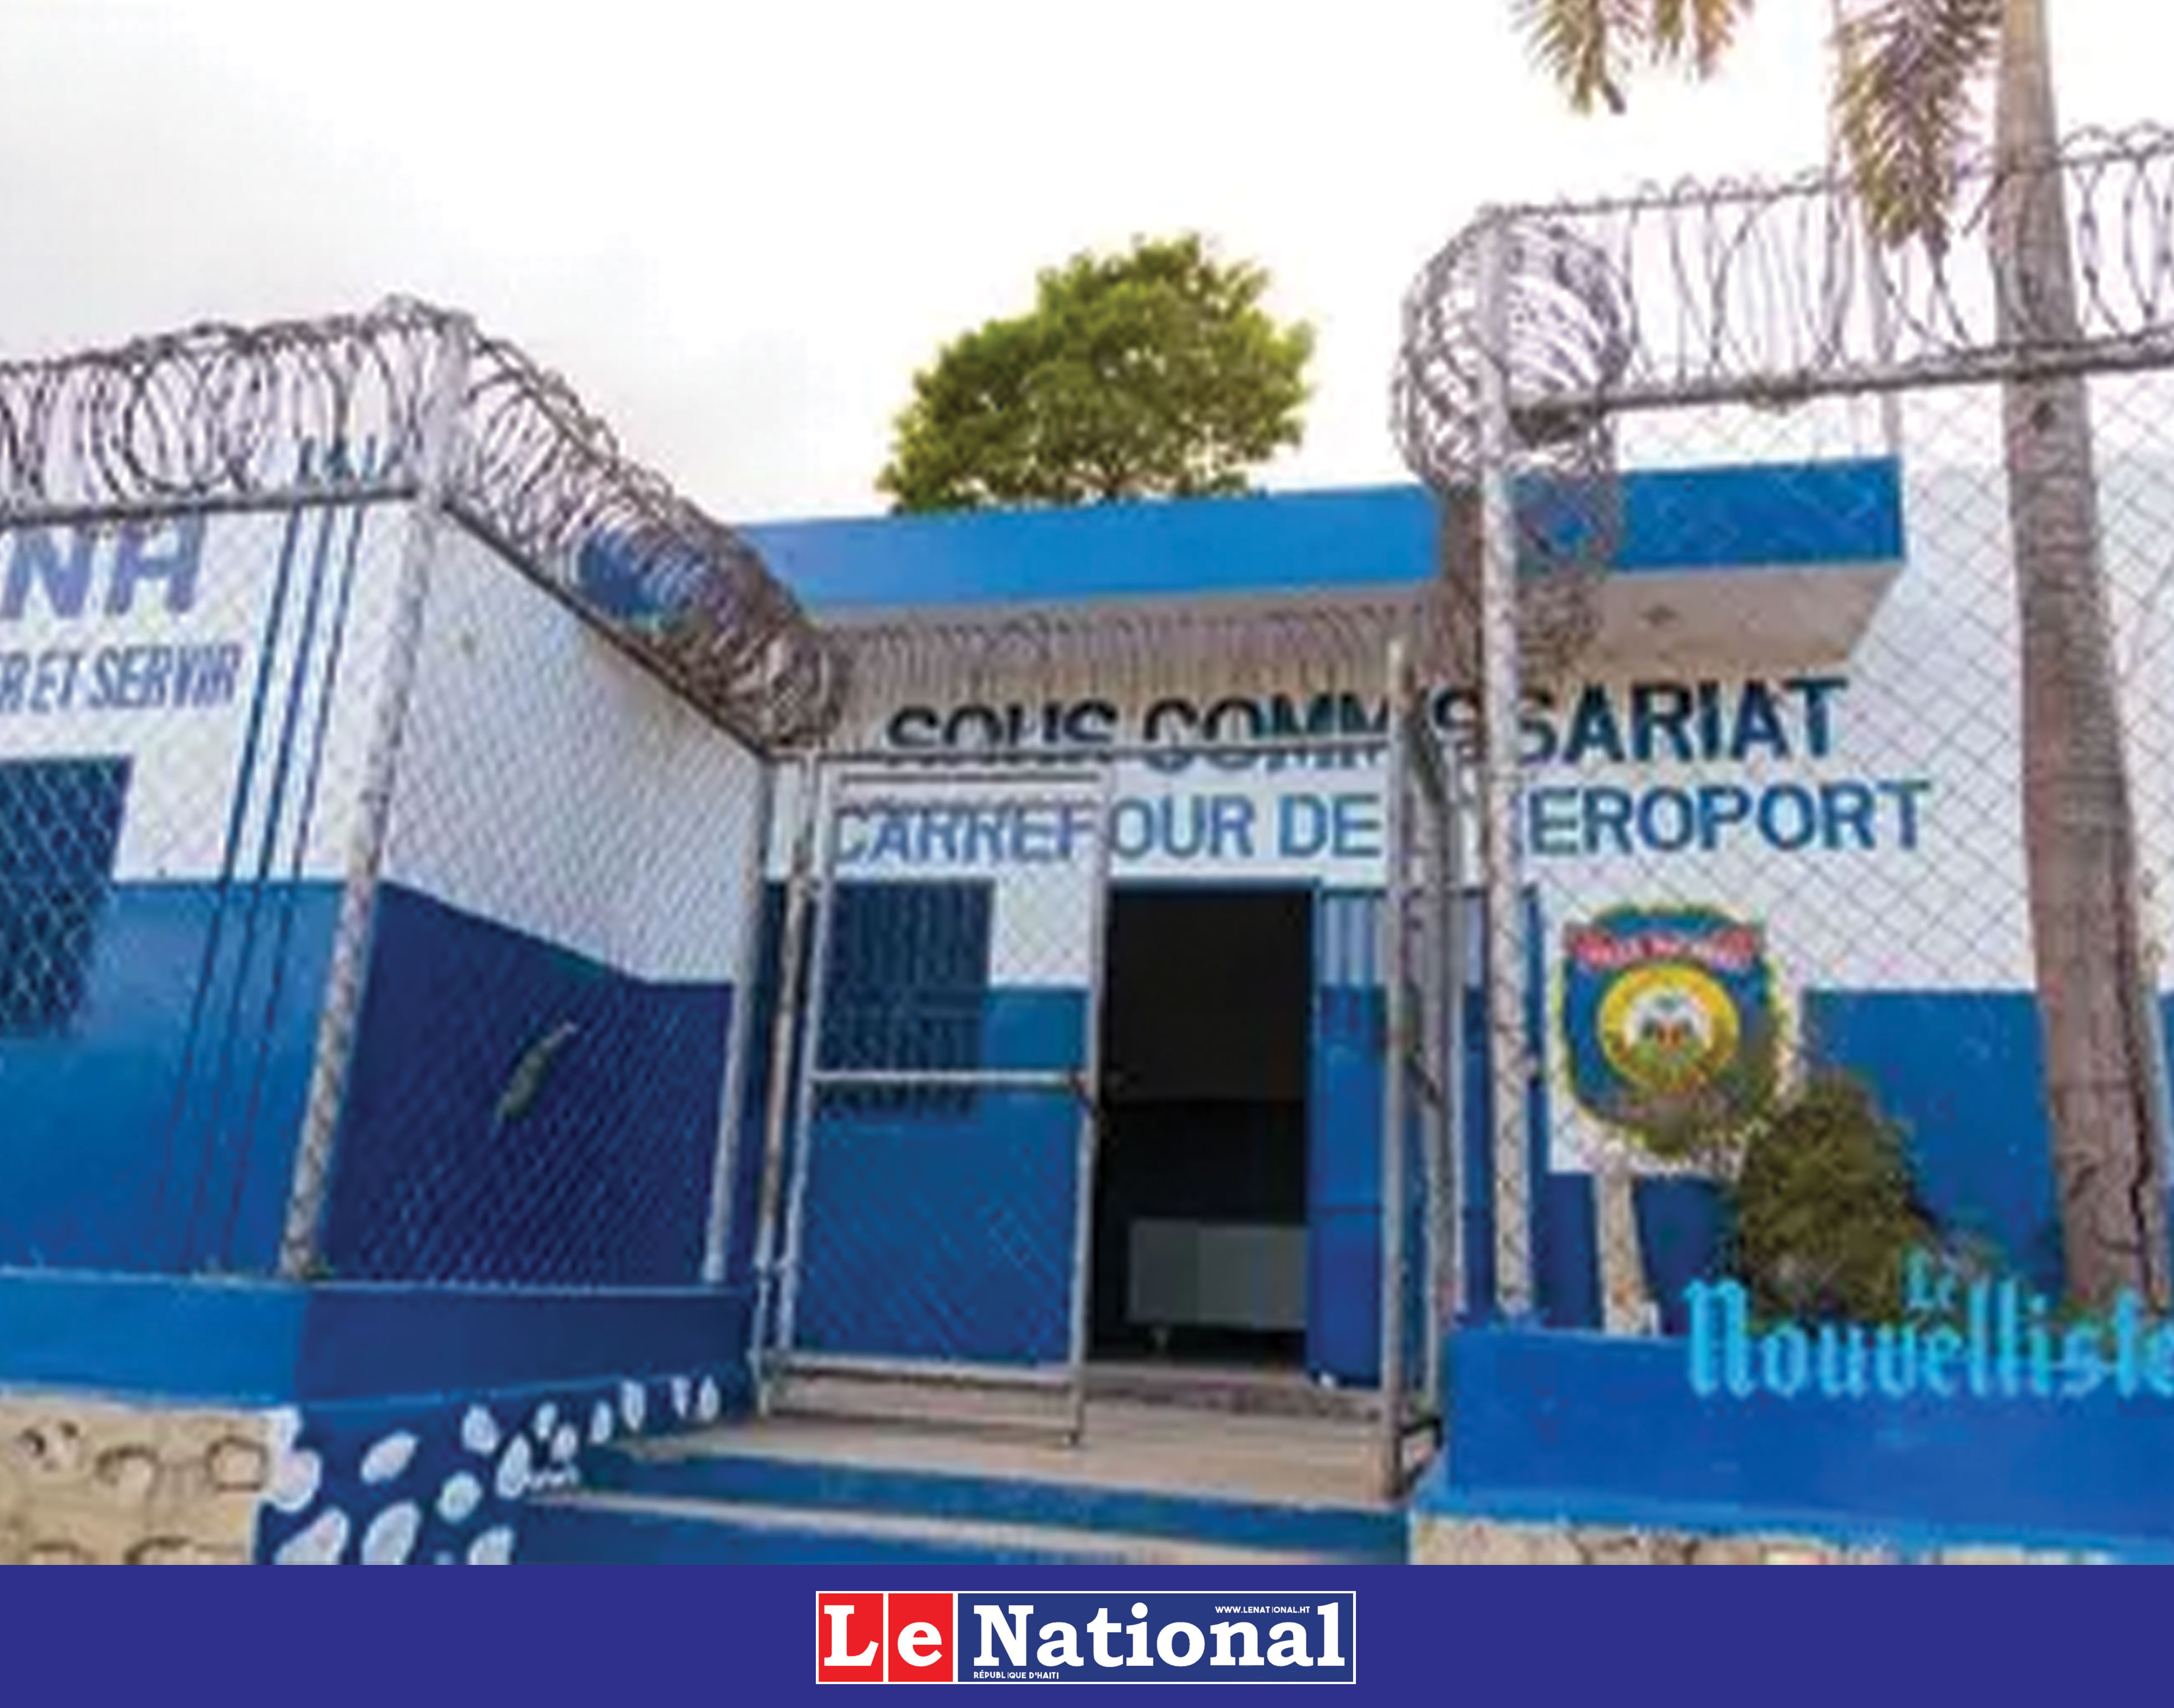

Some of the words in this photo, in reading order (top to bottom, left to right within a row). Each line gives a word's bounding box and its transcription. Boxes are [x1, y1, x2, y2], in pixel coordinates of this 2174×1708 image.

[31, 648, 83, 714] ET
[89, 643, 242, 709] SERVIR
[887, 700, 1117, 764] SOUS
[1144, 678, 1849, 774] COMMSSARIAT
[833, 794, 1256, 863] CARREFOUR
[1278, 793, 1381, 858] DE
